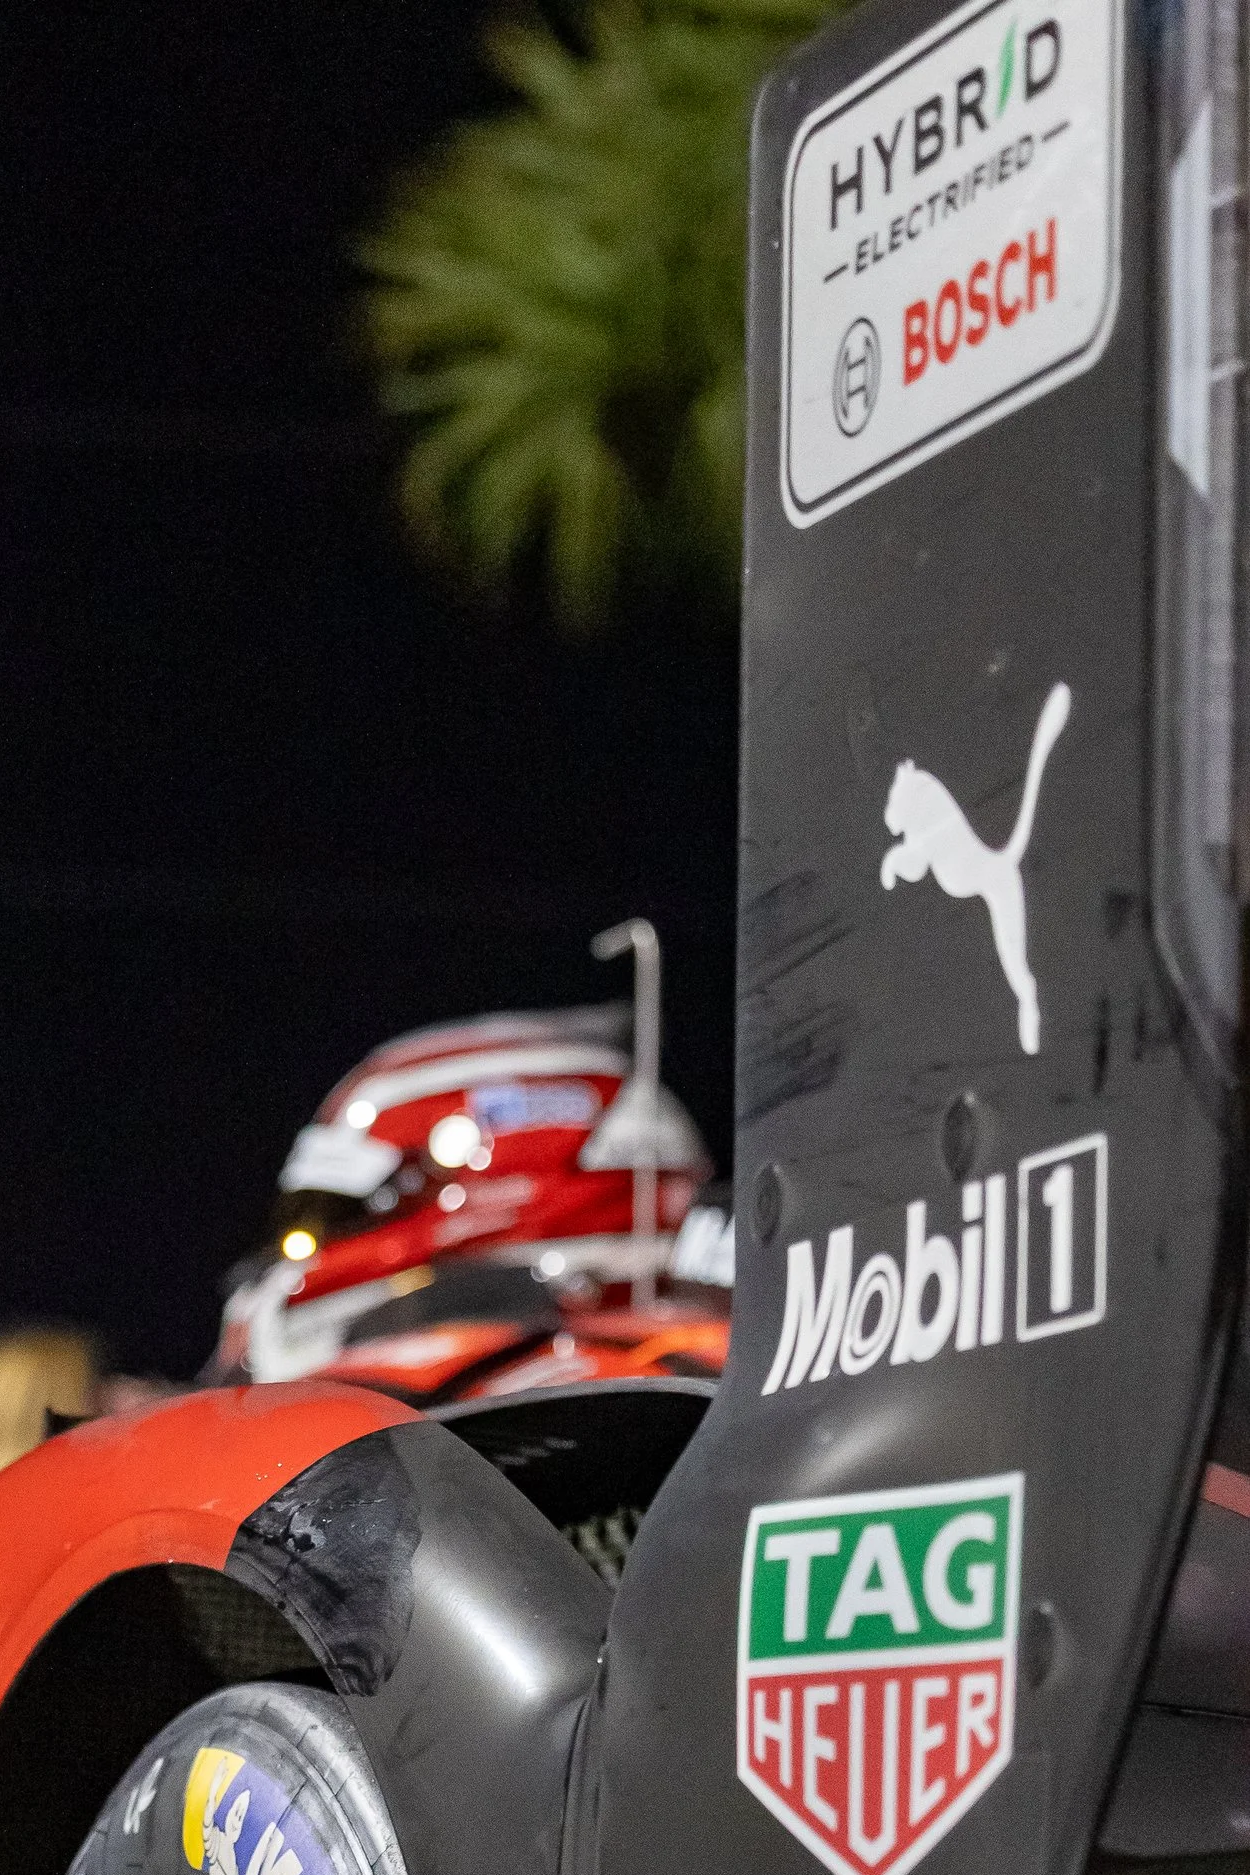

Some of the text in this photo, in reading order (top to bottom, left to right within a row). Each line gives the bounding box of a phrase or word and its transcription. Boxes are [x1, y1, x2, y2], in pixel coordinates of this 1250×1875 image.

[830, 17, 1062, 230] HYBRID
[854, 136, 1034, 275] ELECTRIFIED
[903, 218, 1058, 387] BOSCH
[761, 1173, 1006, 1396] Mobil
[764, 1511, 998, 1643] TAG
[753, 1672, 1000, 1868] HEUER
